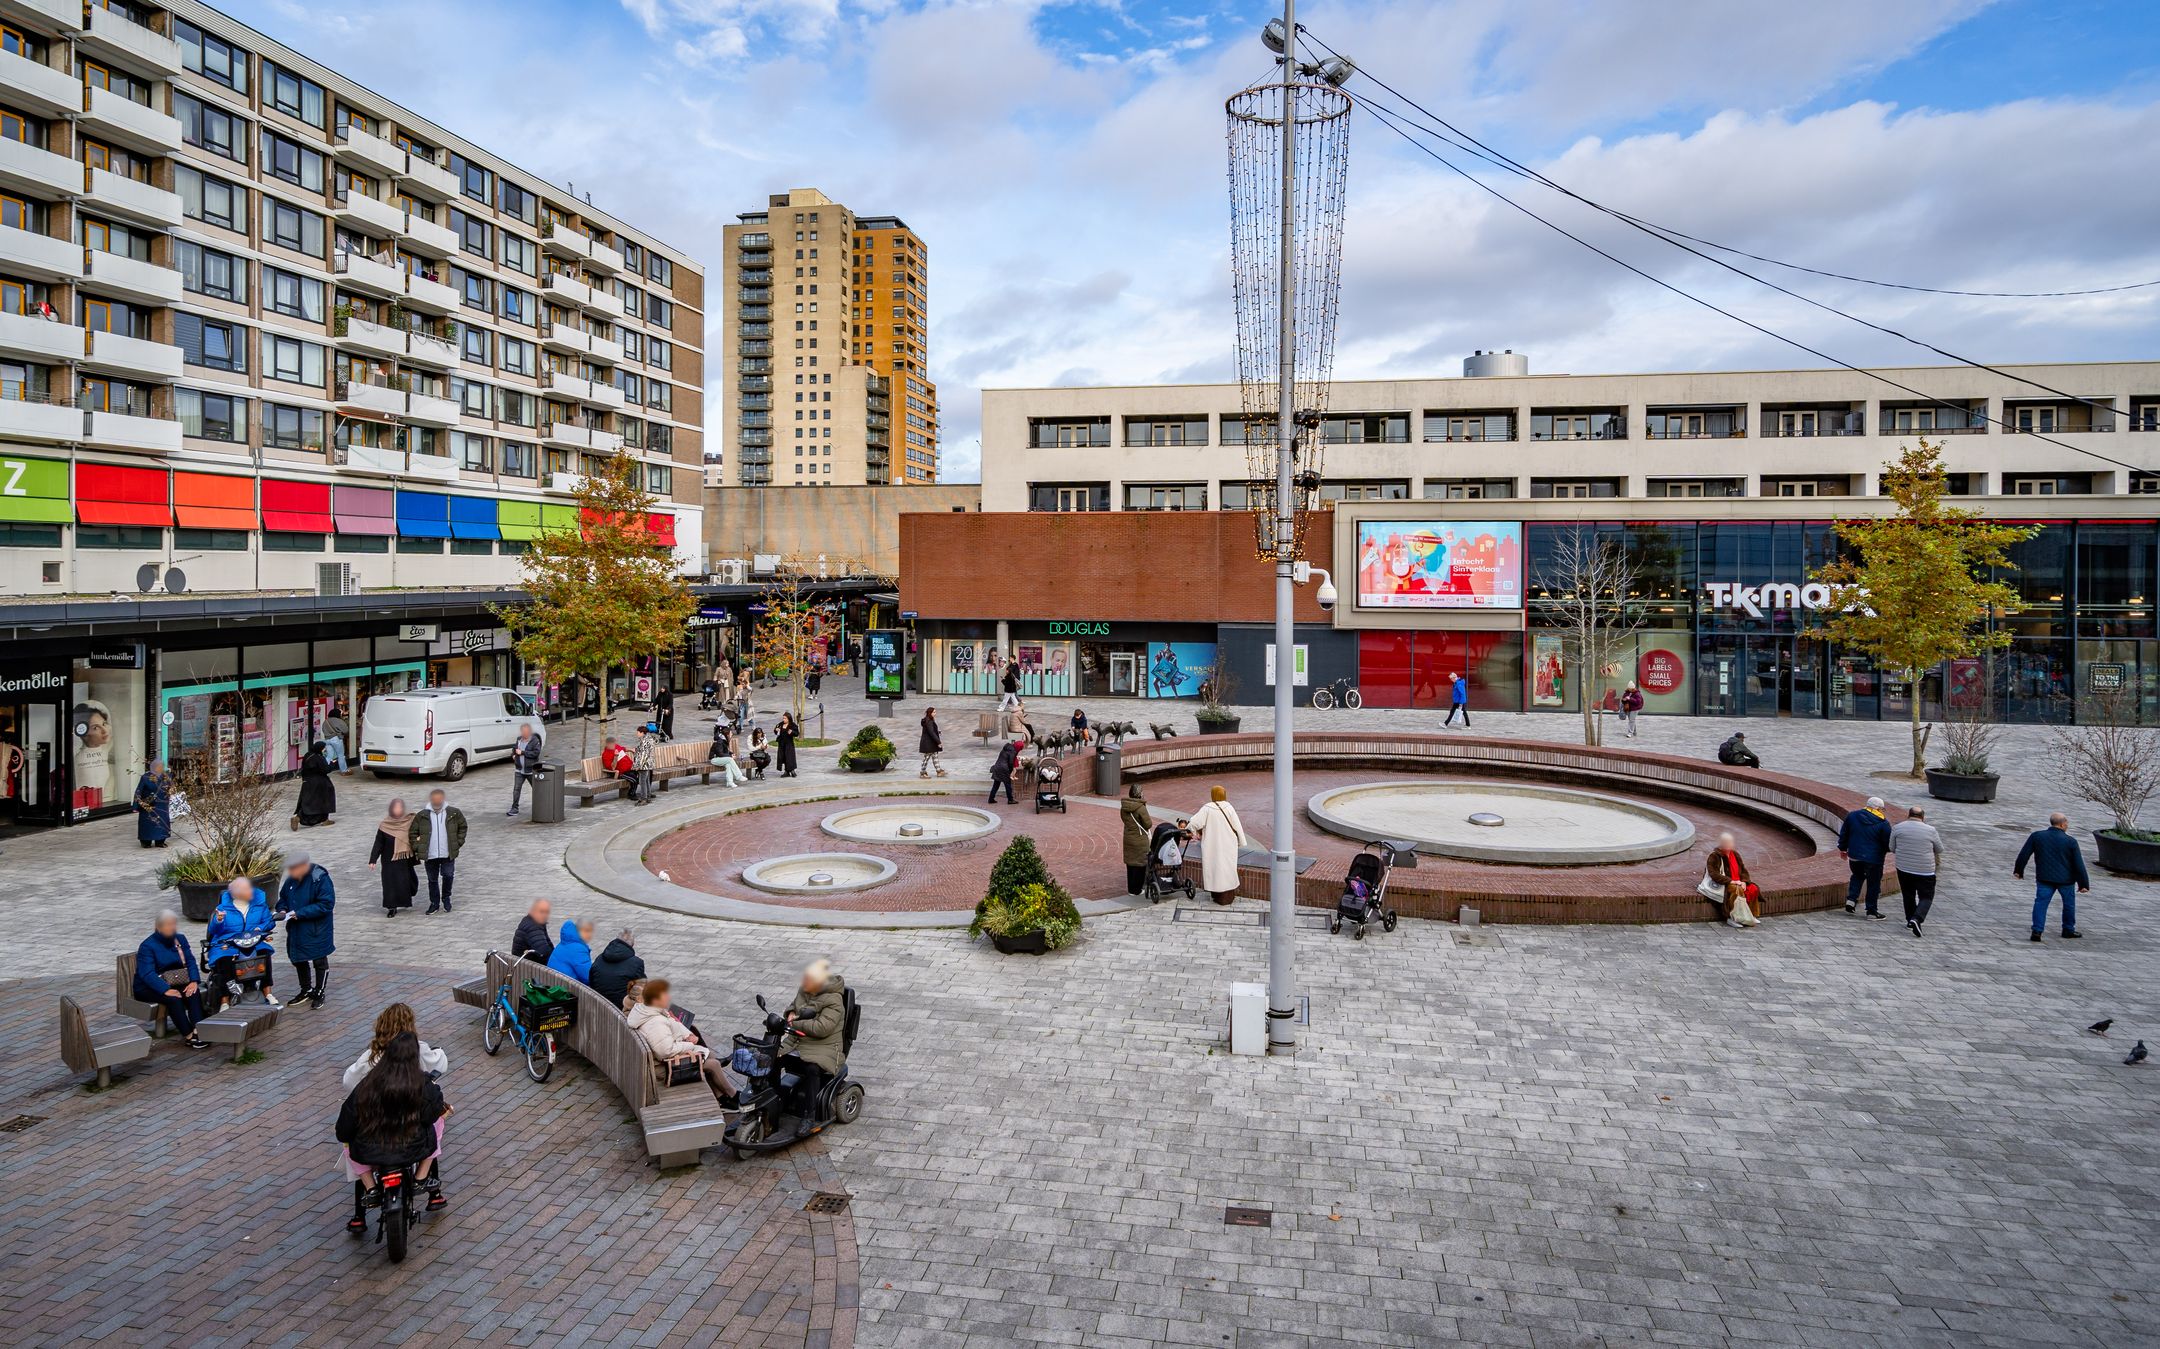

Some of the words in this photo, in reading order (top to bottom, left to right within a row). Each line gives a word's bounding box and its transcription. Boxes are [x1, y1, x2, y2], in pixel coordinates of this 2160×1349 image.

[4, 461, 26, 495] Z
[1453, 557, 1485, 565] Intocht
[410, 626, 426, 638] Etos
[1049, 622, 1110, 635] DOUGLAS
[464, 630, 486, 654] Etos
[91, 652, 134, 661] hunkemöller
[956, 646, 972, 660] 20
